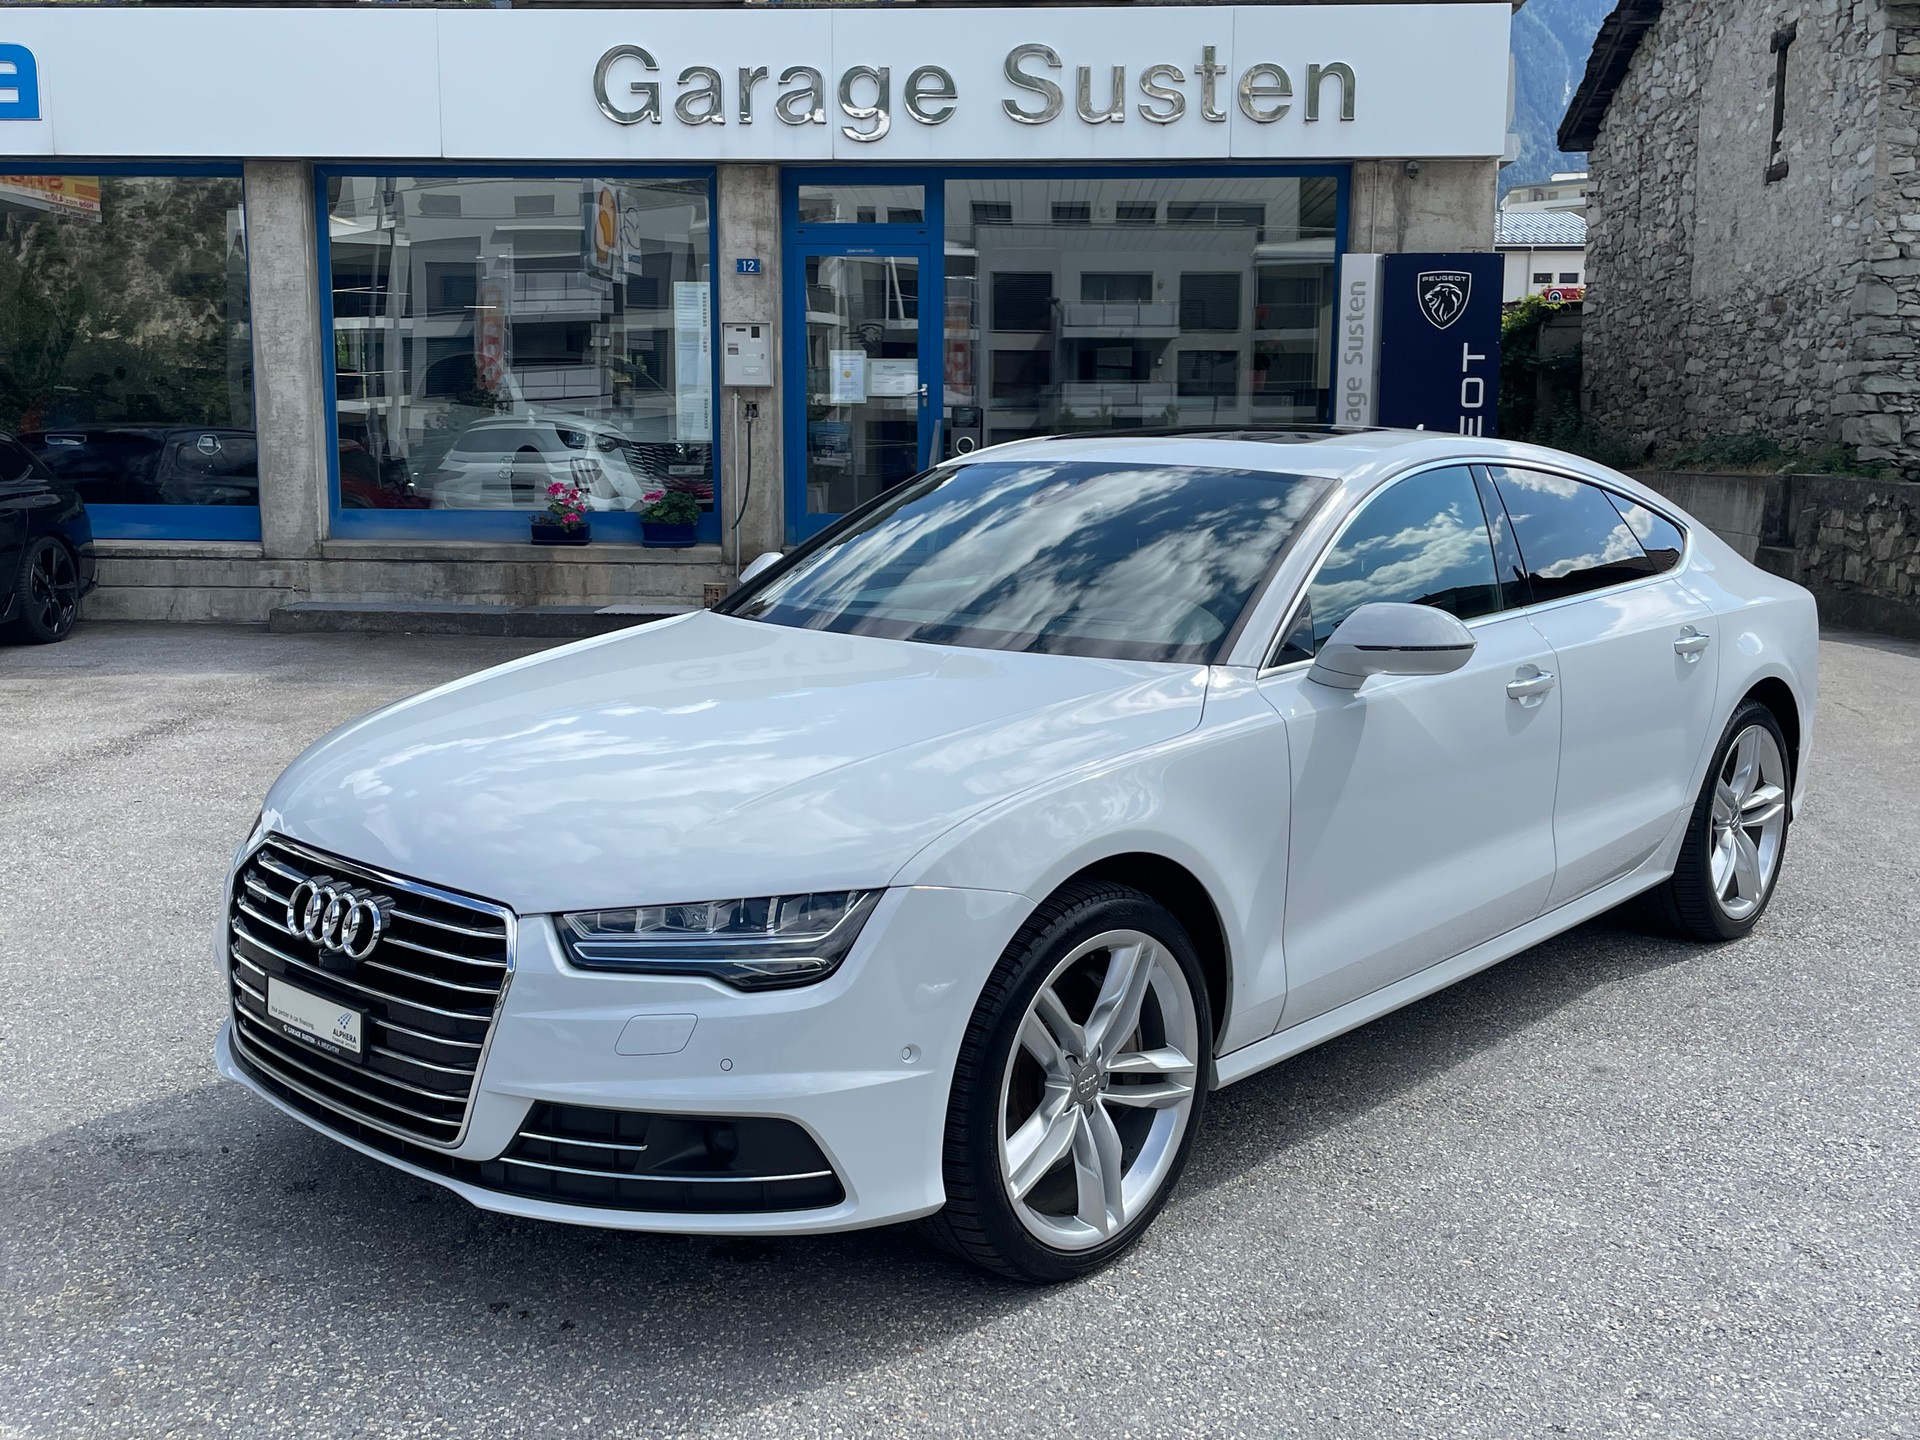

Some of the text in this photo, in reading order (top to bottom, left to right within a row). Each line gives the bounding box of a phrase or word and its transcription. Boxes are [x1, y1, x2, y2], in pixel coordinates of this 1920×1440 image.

[593, 42, 1355, 142] Garage Susten
[742, 260, 755, 272] 12
[1343, 281, 1367, 365] Susten
[332, 1028, 357, 1044] ALPHERA
